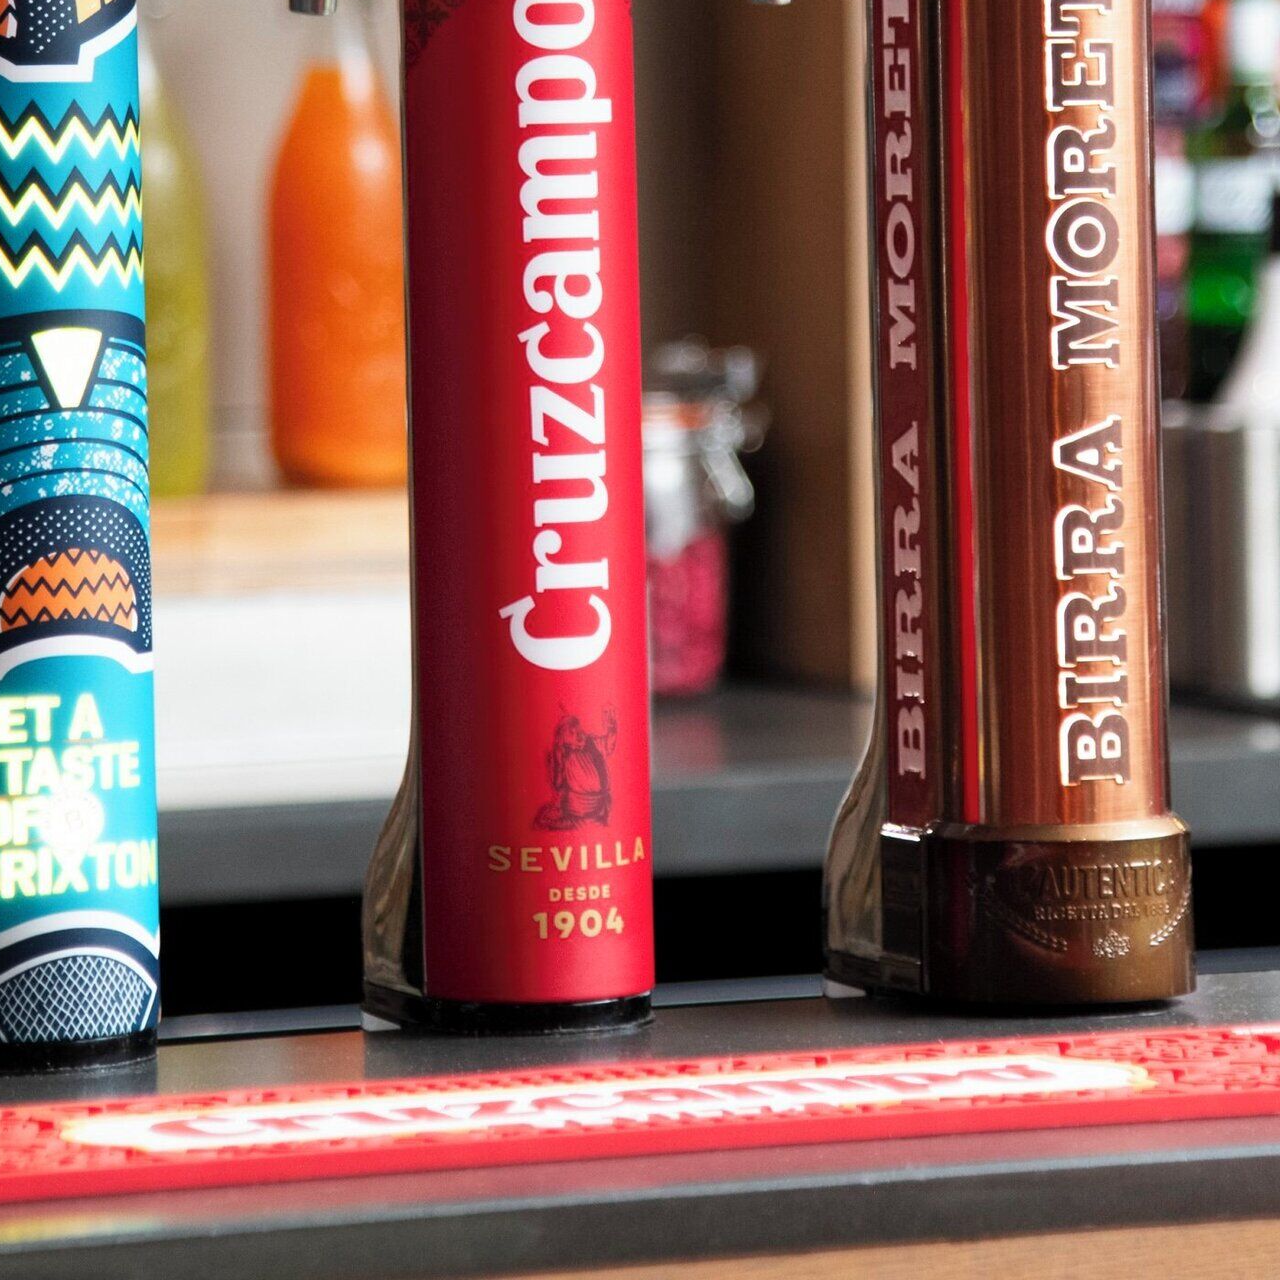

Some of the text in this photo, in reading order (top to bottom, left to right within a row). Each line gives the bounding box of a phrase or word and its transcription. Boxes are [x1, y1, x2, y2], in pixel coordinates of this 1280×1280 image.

[891, 421, 927, 780] BIRRA
[1052, 414, 1130, 787] BIRRA
[68, 692, 105, 741] A
[488, 836, 645, 873] SEVILLA
[549, 884, 611, 902] DESDE
[532, 907, 624, 939] 1904
[149, 1062, 1063, 1138] Cruzcampo
